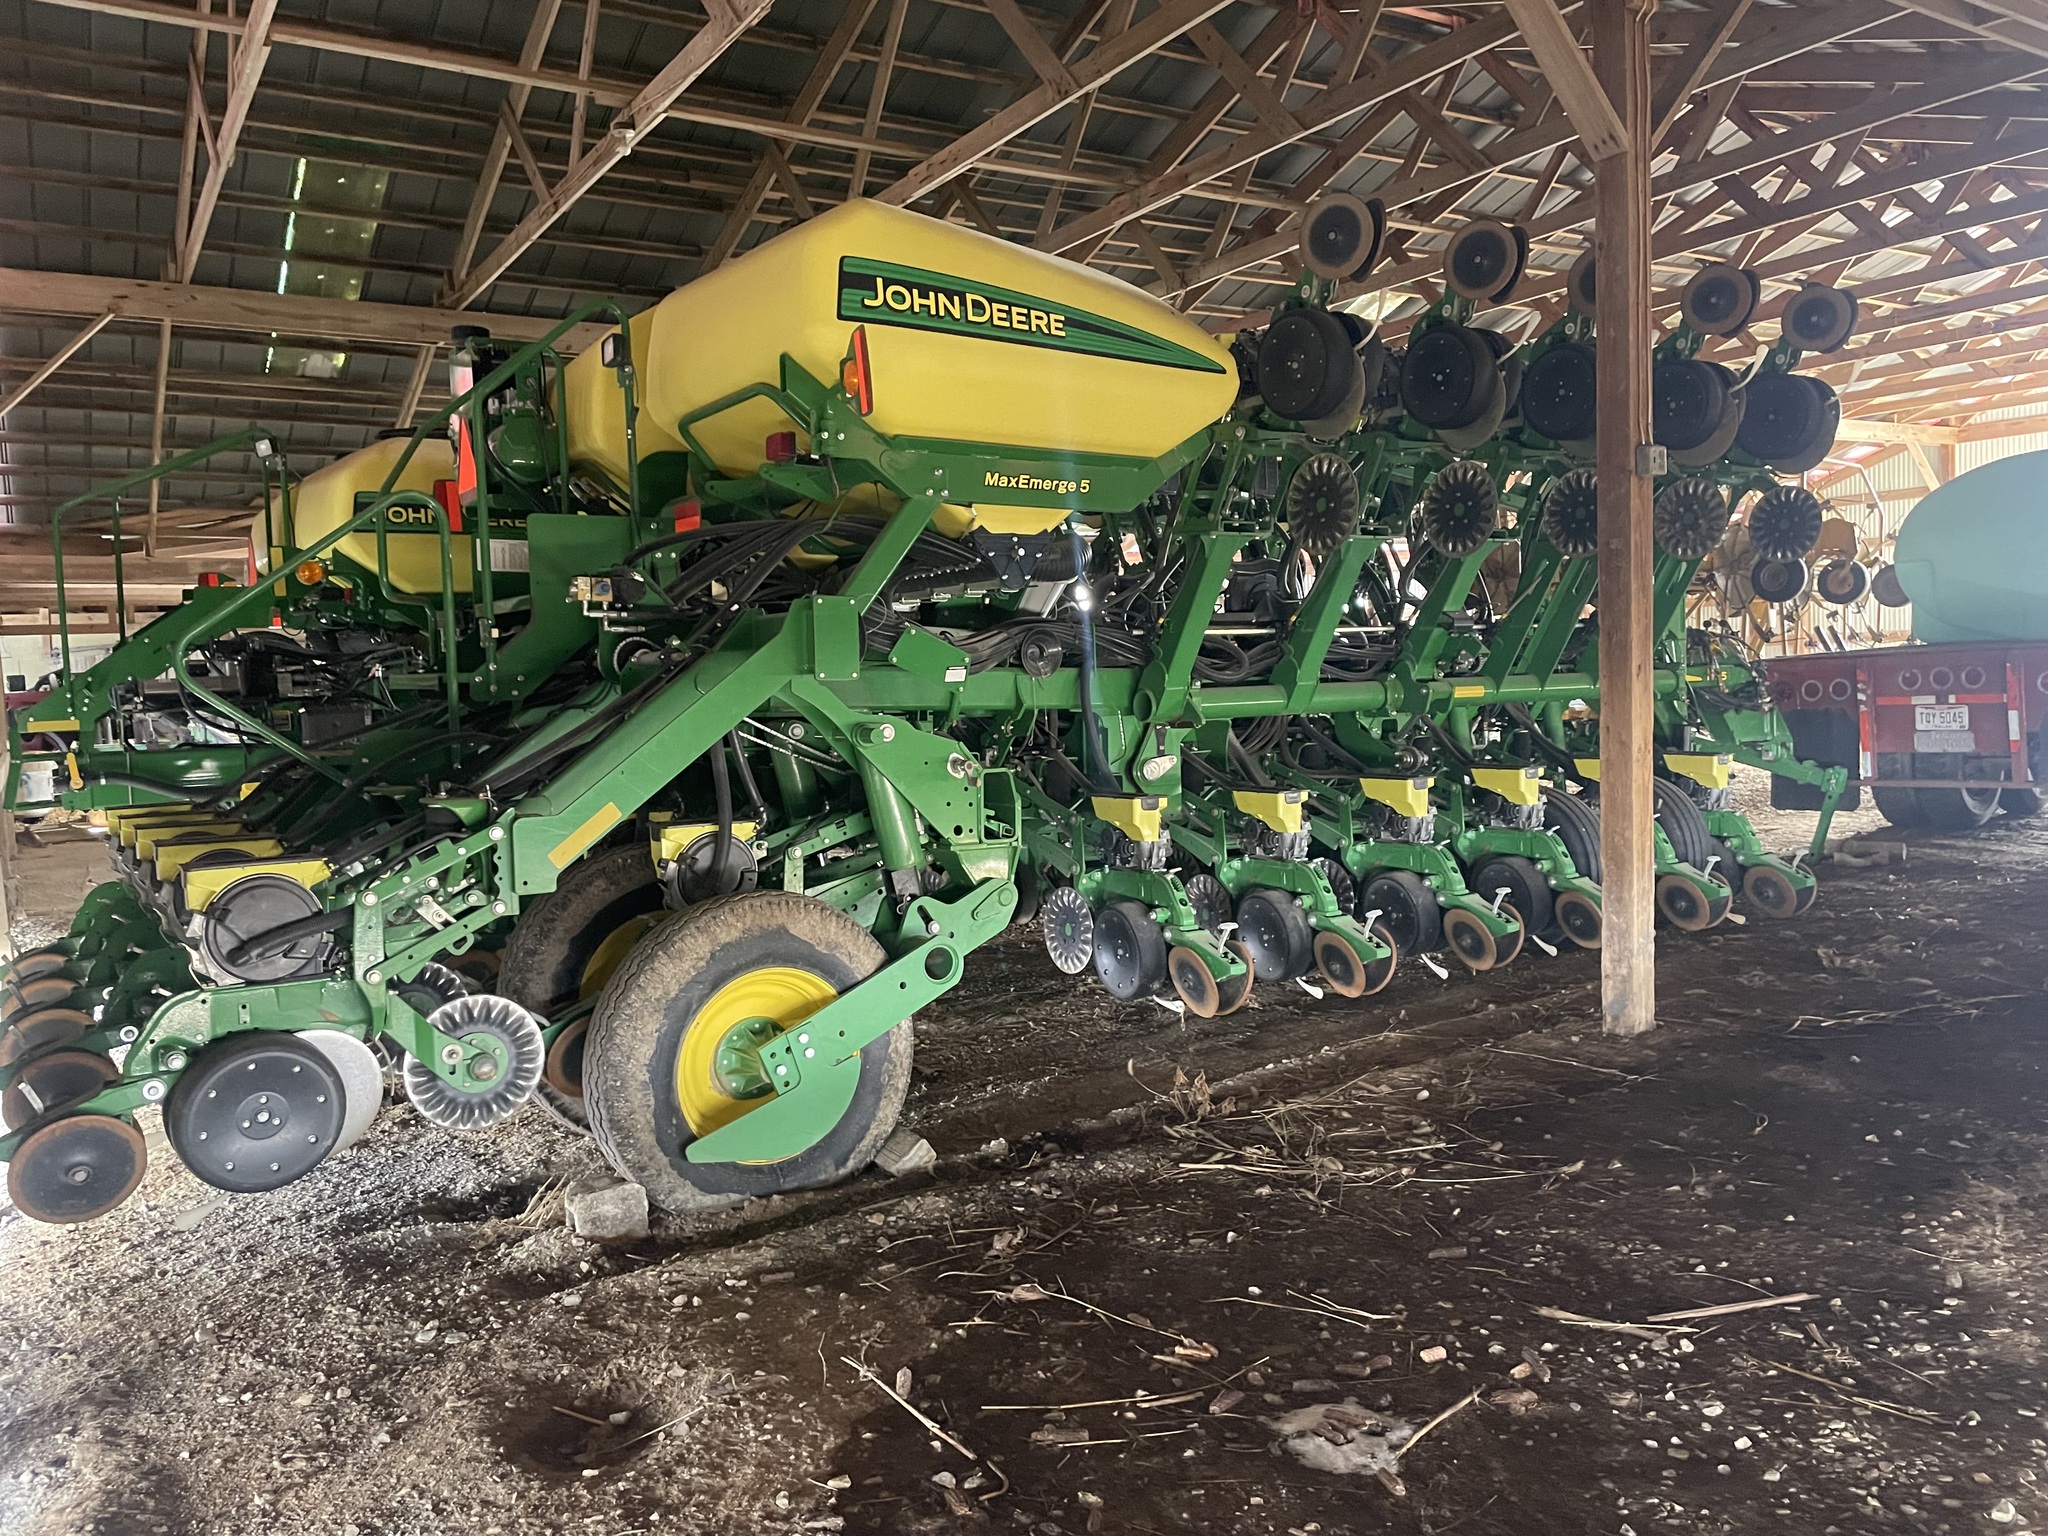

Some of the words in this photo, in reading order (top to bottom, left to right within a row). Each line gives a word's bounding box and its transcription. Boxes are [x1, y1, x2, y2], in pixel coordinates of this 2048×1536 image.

[864, 277, 960, 319] JOHN
[965, 292, 1066, 337] DEERE
[984, 471, 1077, 494] MaxEmerge
[1079, 479, 1091, 493] 5
[1939, 711, 1964, 724] 5045
